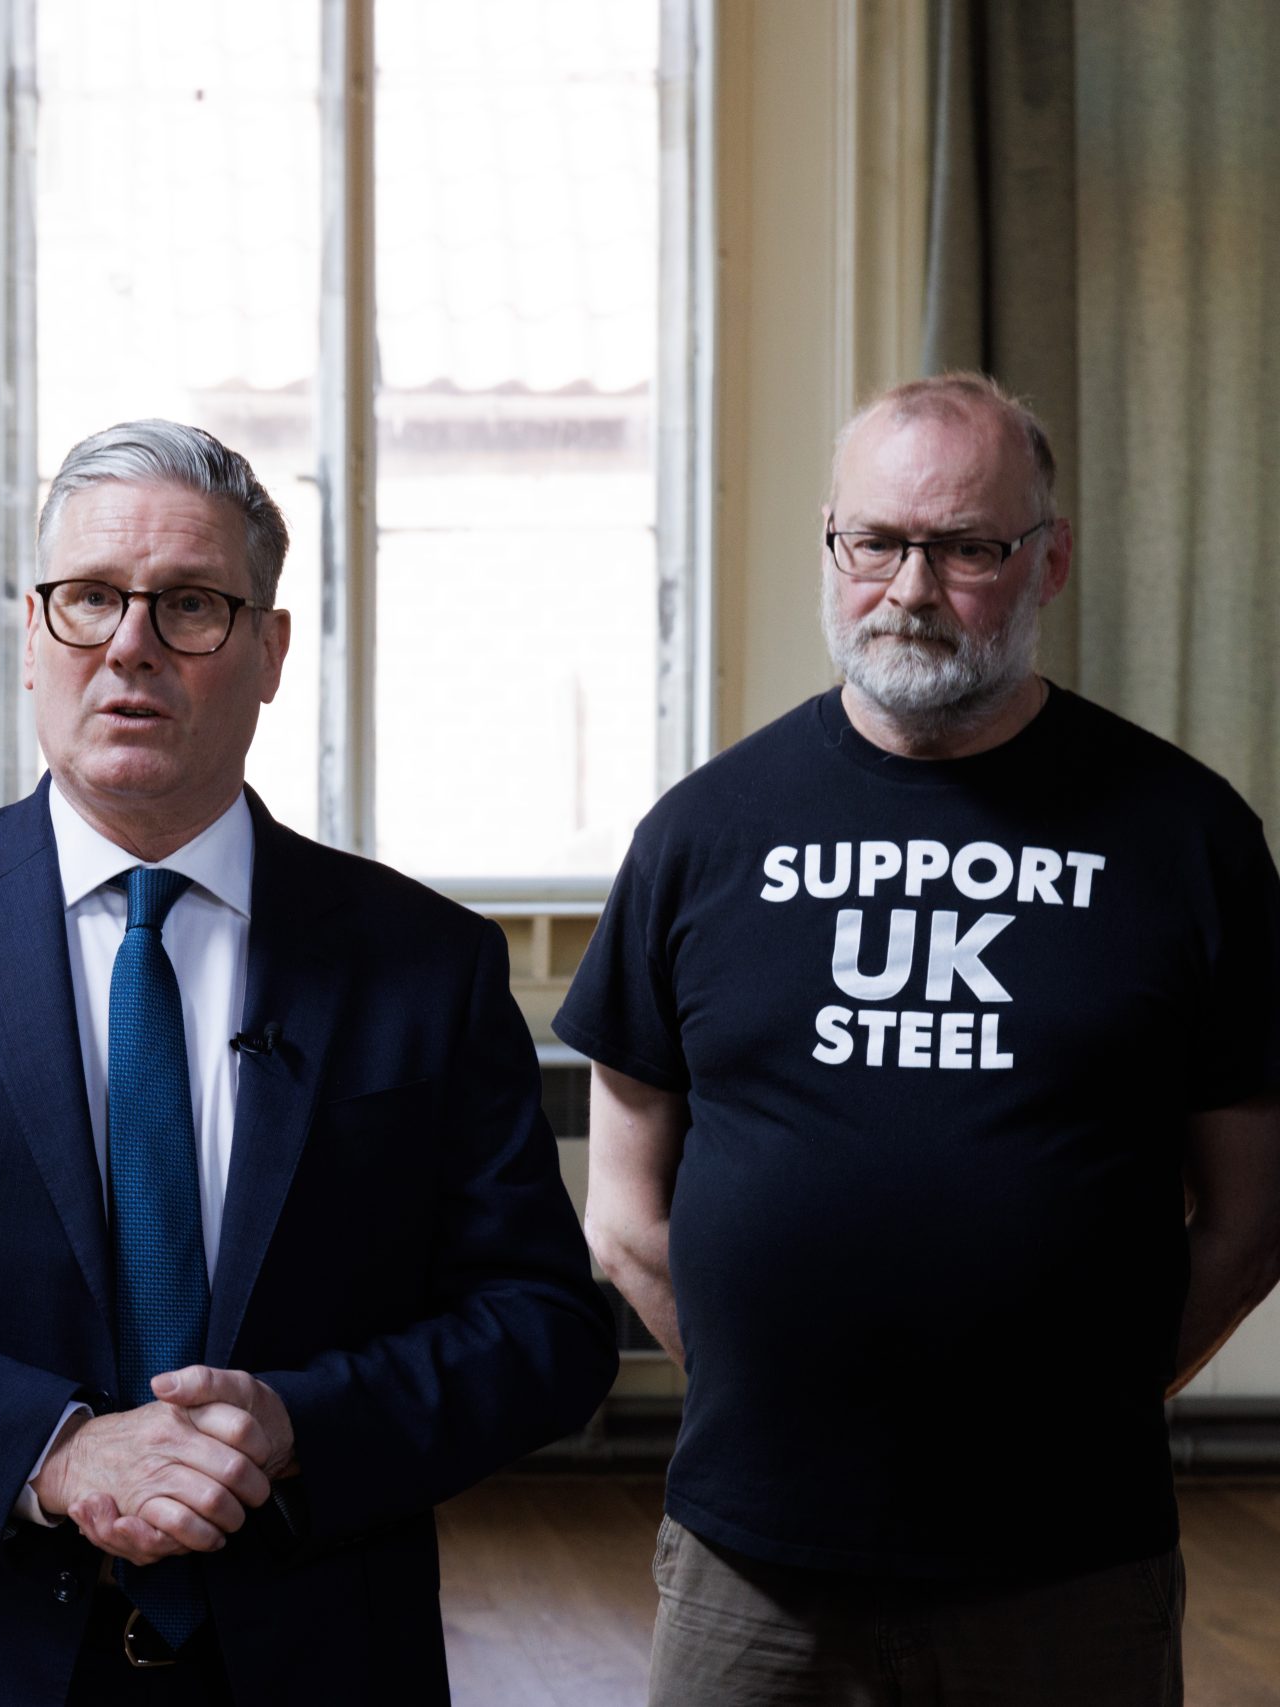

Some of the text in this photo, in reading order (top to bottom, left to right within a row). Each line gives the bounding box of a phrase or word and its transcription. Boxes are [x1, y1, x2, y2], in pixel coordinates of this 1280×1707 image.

[760, 840, 1106, 908] SUPPORT
[832, 909, 1016, 1002] UK
[812, 1005, 1013, 1069] STEEL
